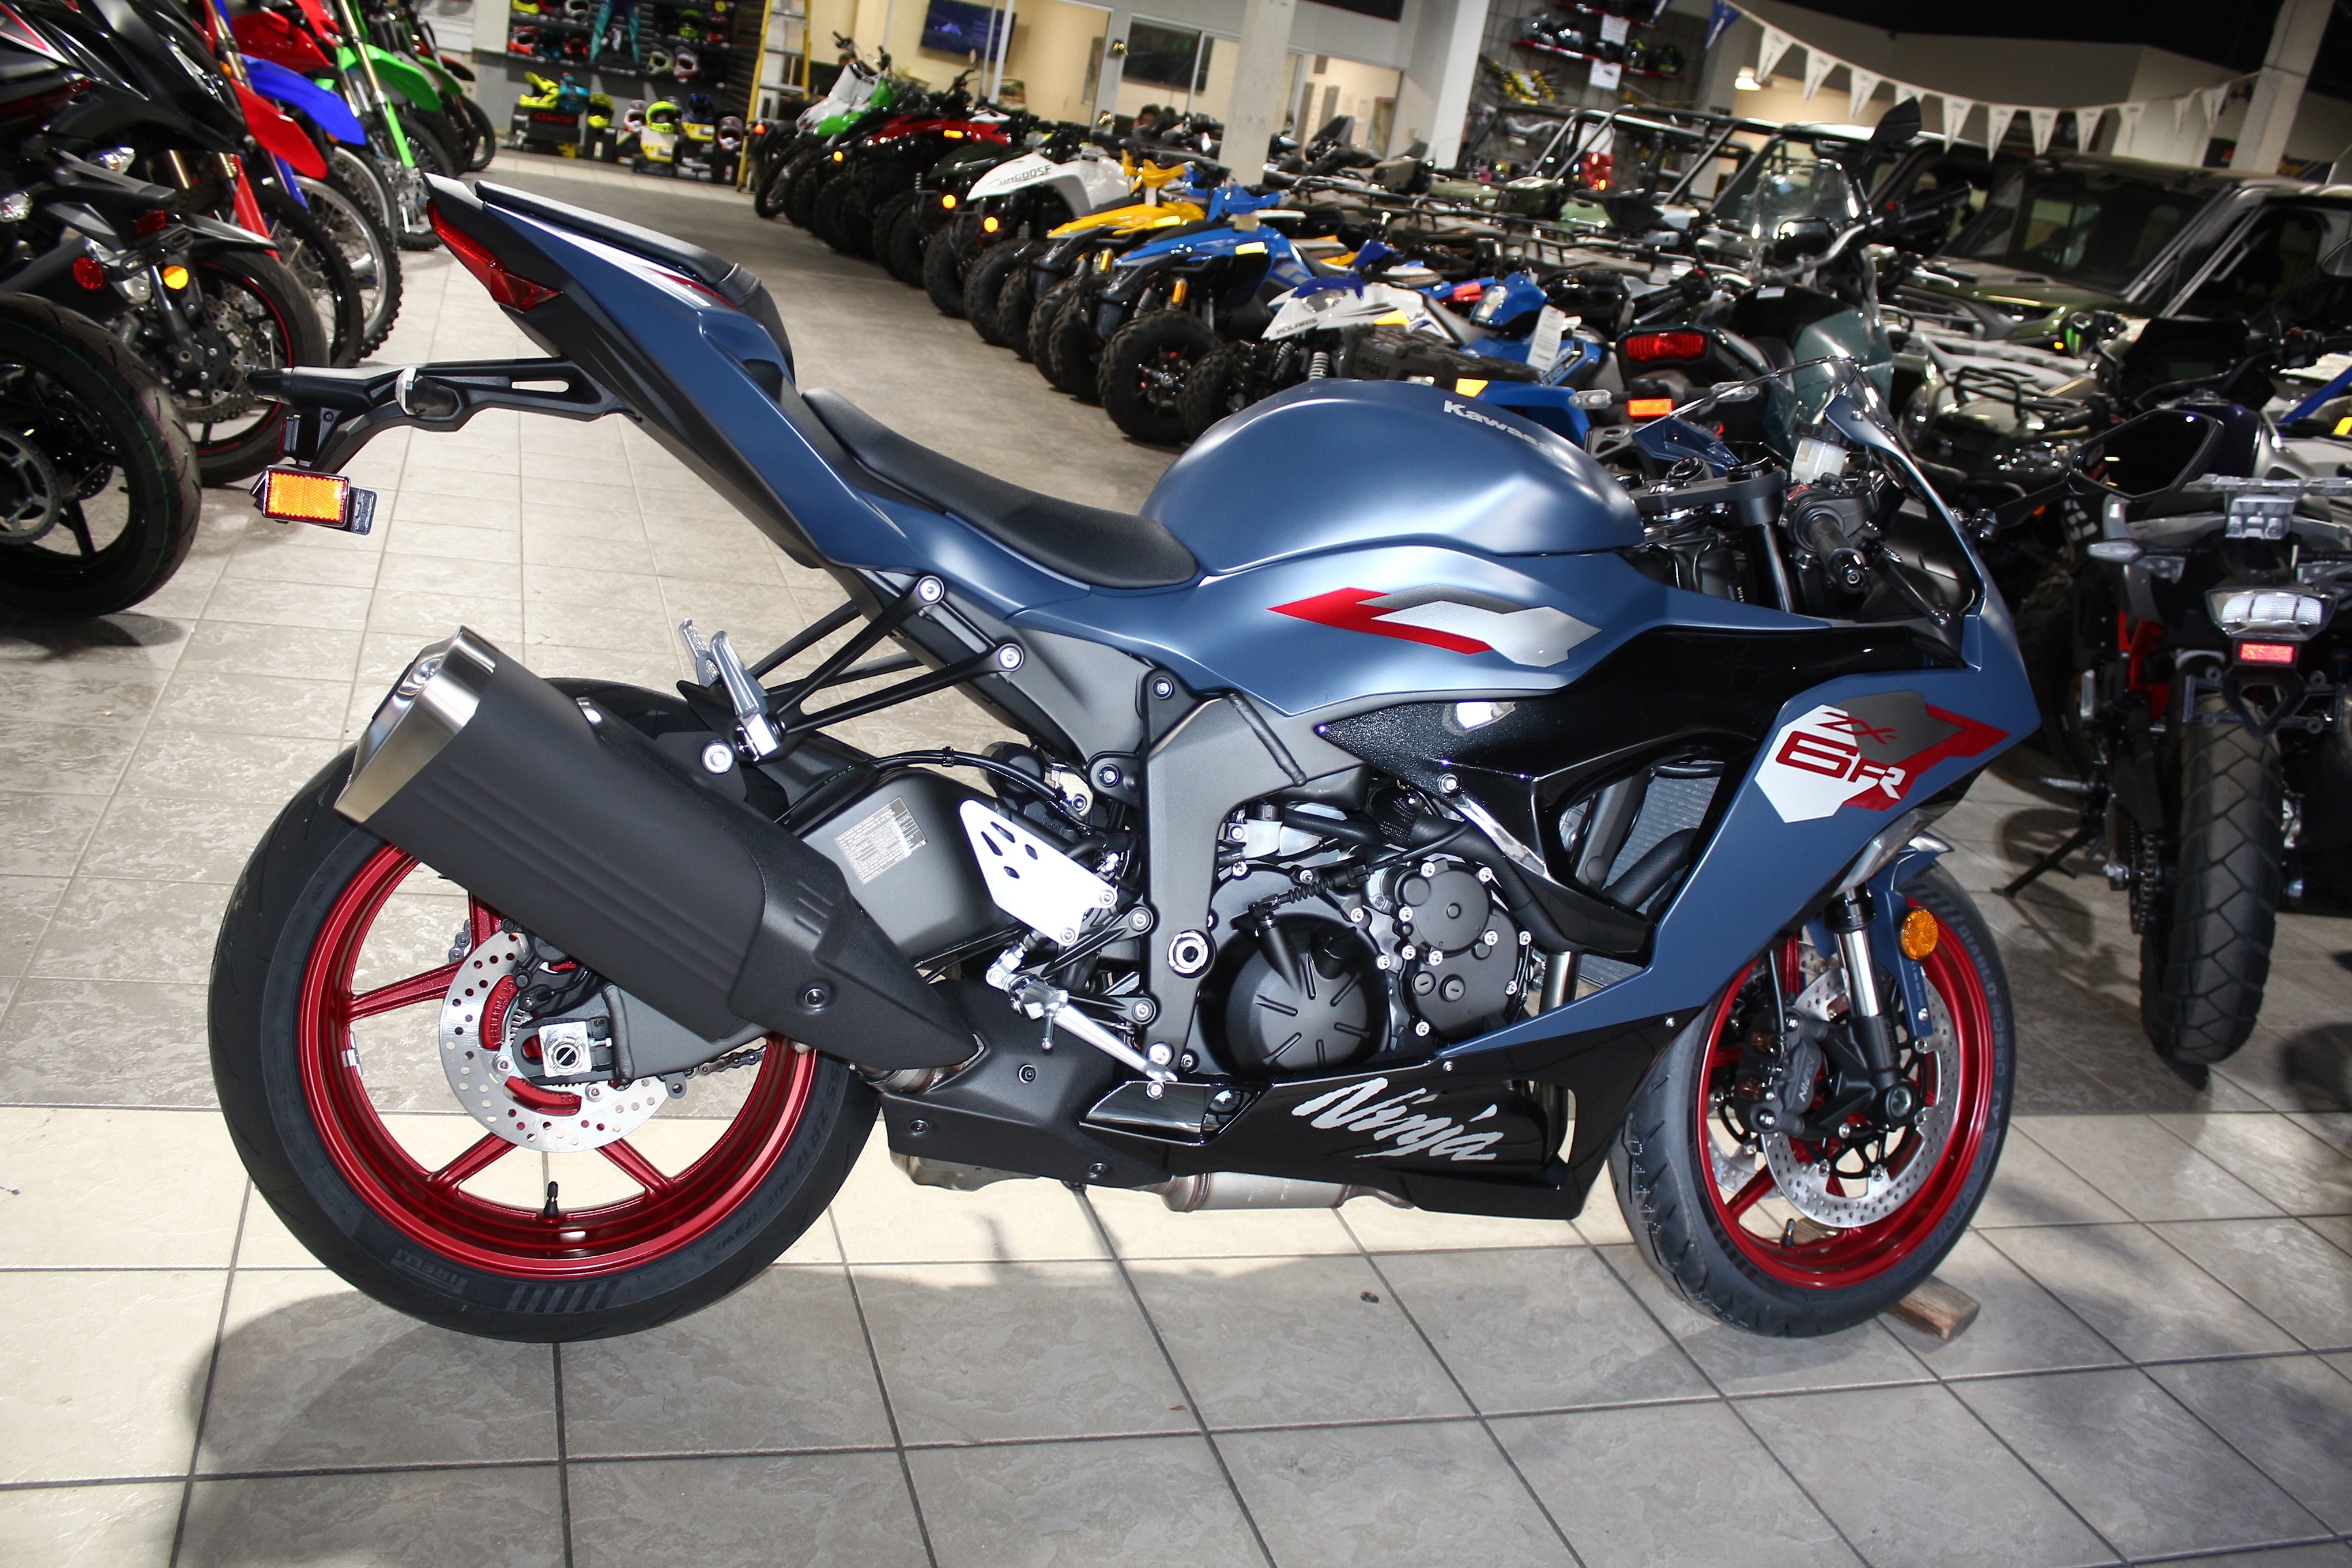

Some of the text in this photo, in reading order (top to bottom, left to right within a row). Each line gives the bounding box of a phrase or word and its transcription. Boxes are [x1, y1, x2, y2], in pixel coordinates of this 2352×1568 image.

[1276, 318, 1318, 336] POLARIS
[1957, 923, 1997, 996] DIABLO
[1992, 1003, 2006, 1077] ROSSO
[1292, 1077, 1503, 1162] Ninja
[389, 1247, 470, 1295] PIRELLI
